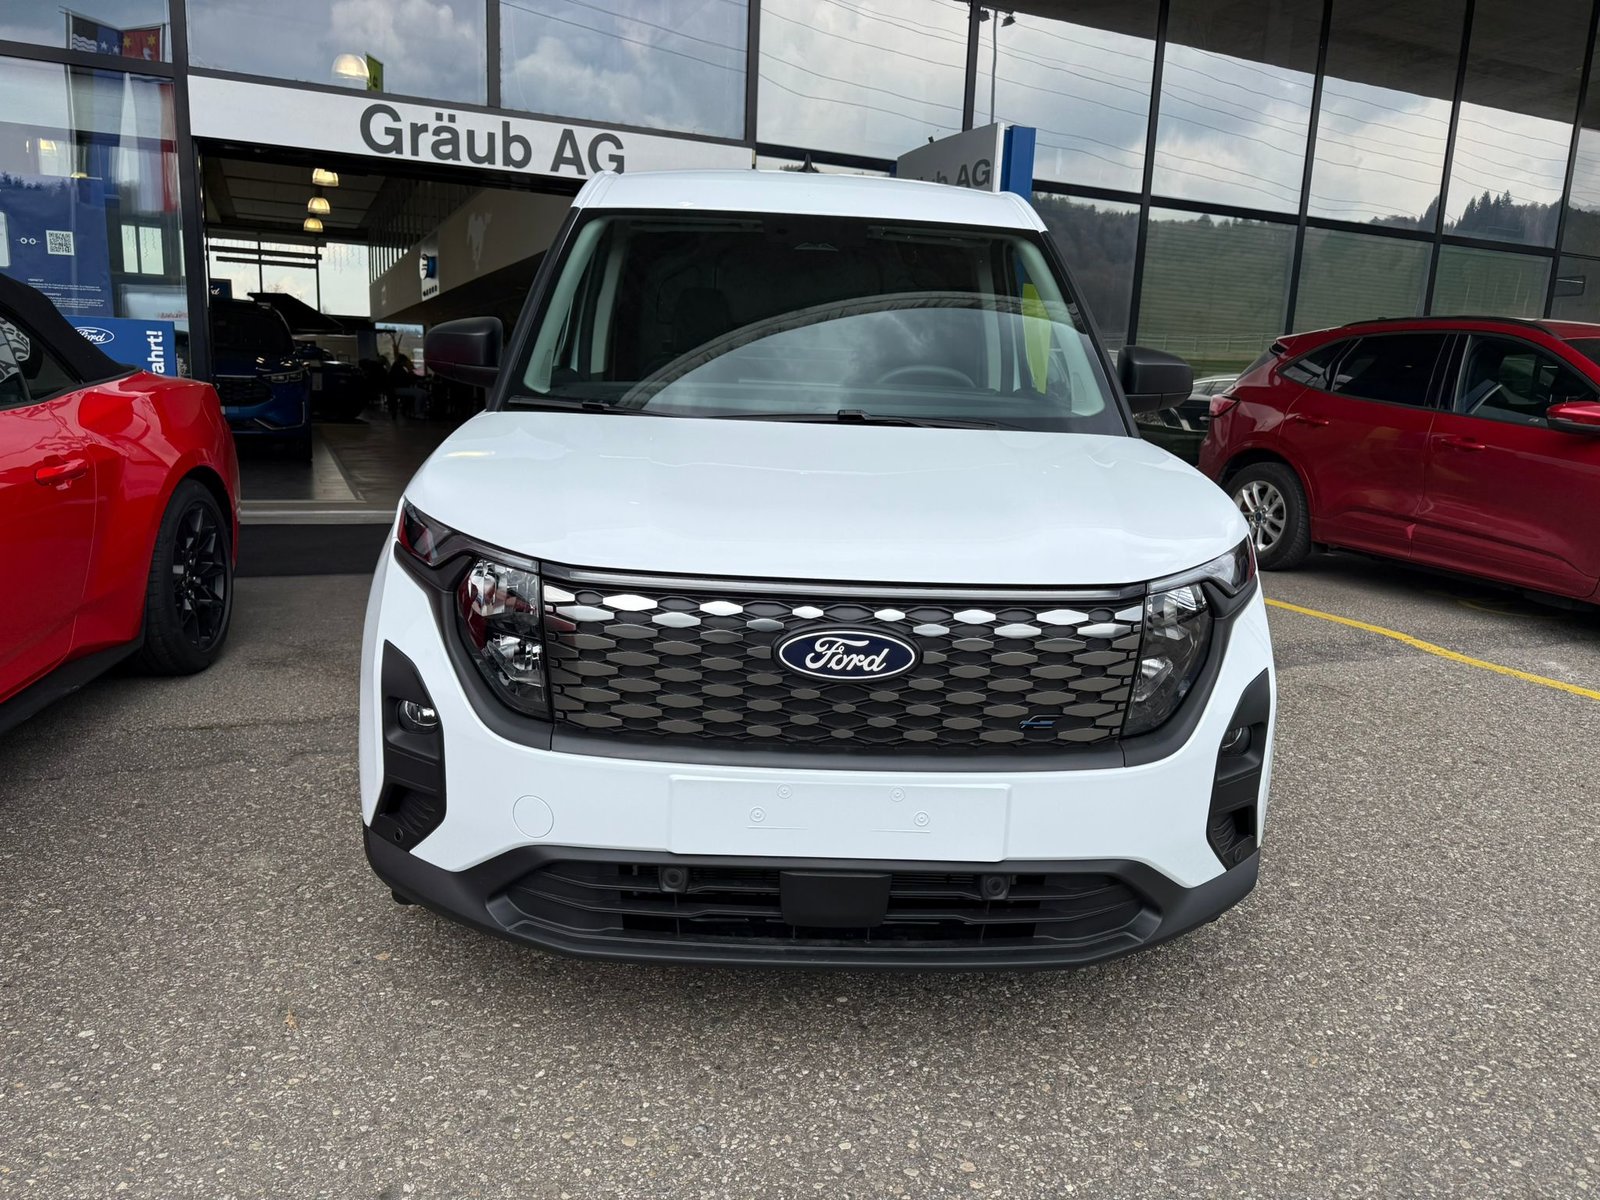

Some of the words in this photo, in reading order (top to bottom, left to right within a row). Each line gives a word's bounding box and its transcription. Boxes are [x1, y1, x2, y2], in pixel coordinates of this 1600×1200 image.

[360, 104, 532, 168] Gräub
[550, 128, 625, 175] AG
[956, 159, 991, 187] AG
[805, 637, 889, 672] Ford
